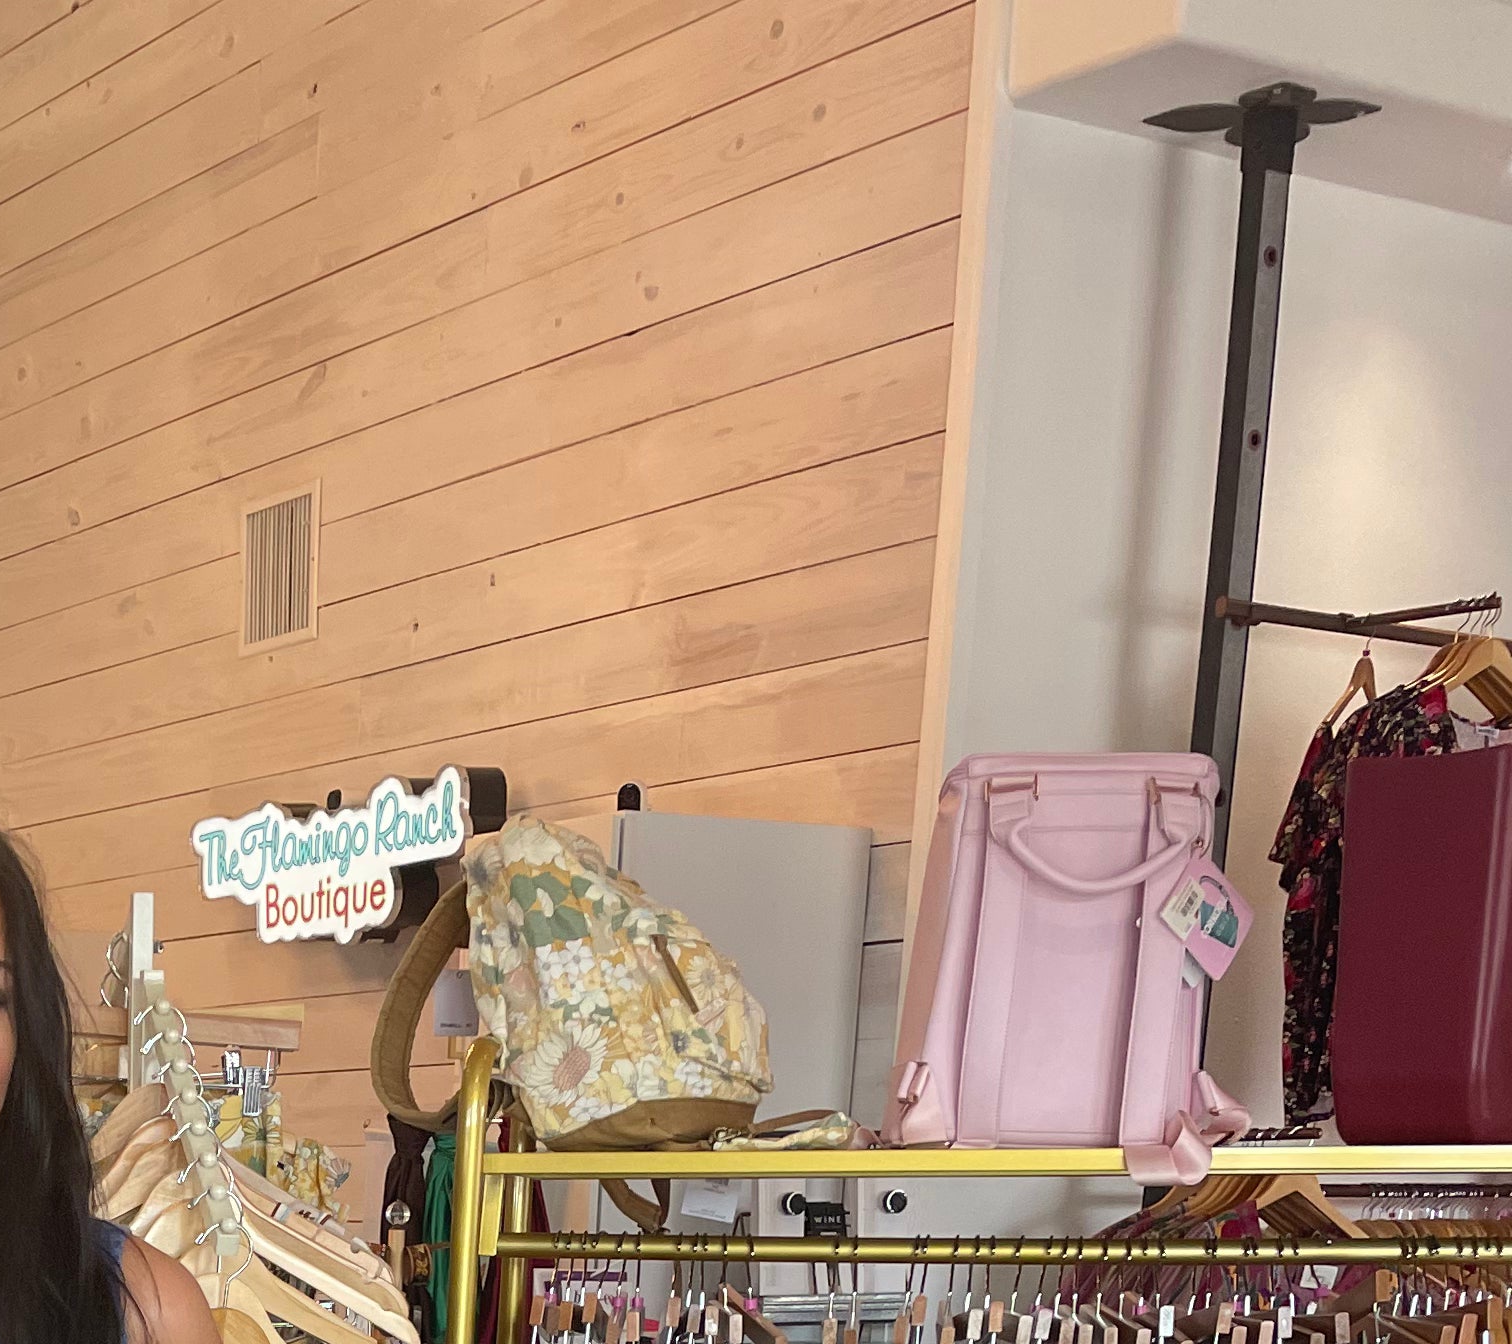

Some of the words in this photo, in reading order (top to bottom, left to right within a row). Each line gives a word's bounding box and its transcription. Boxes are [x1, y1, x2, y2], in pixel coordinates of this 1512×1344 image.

[199, 830, 239, 886] The
[237, 815, 369, 890] Flamingo
[374, 780, 457, 856] Ranch
[265, 876, 387, 928] Boutique
[813, 1215, 841, 1224] WINE
